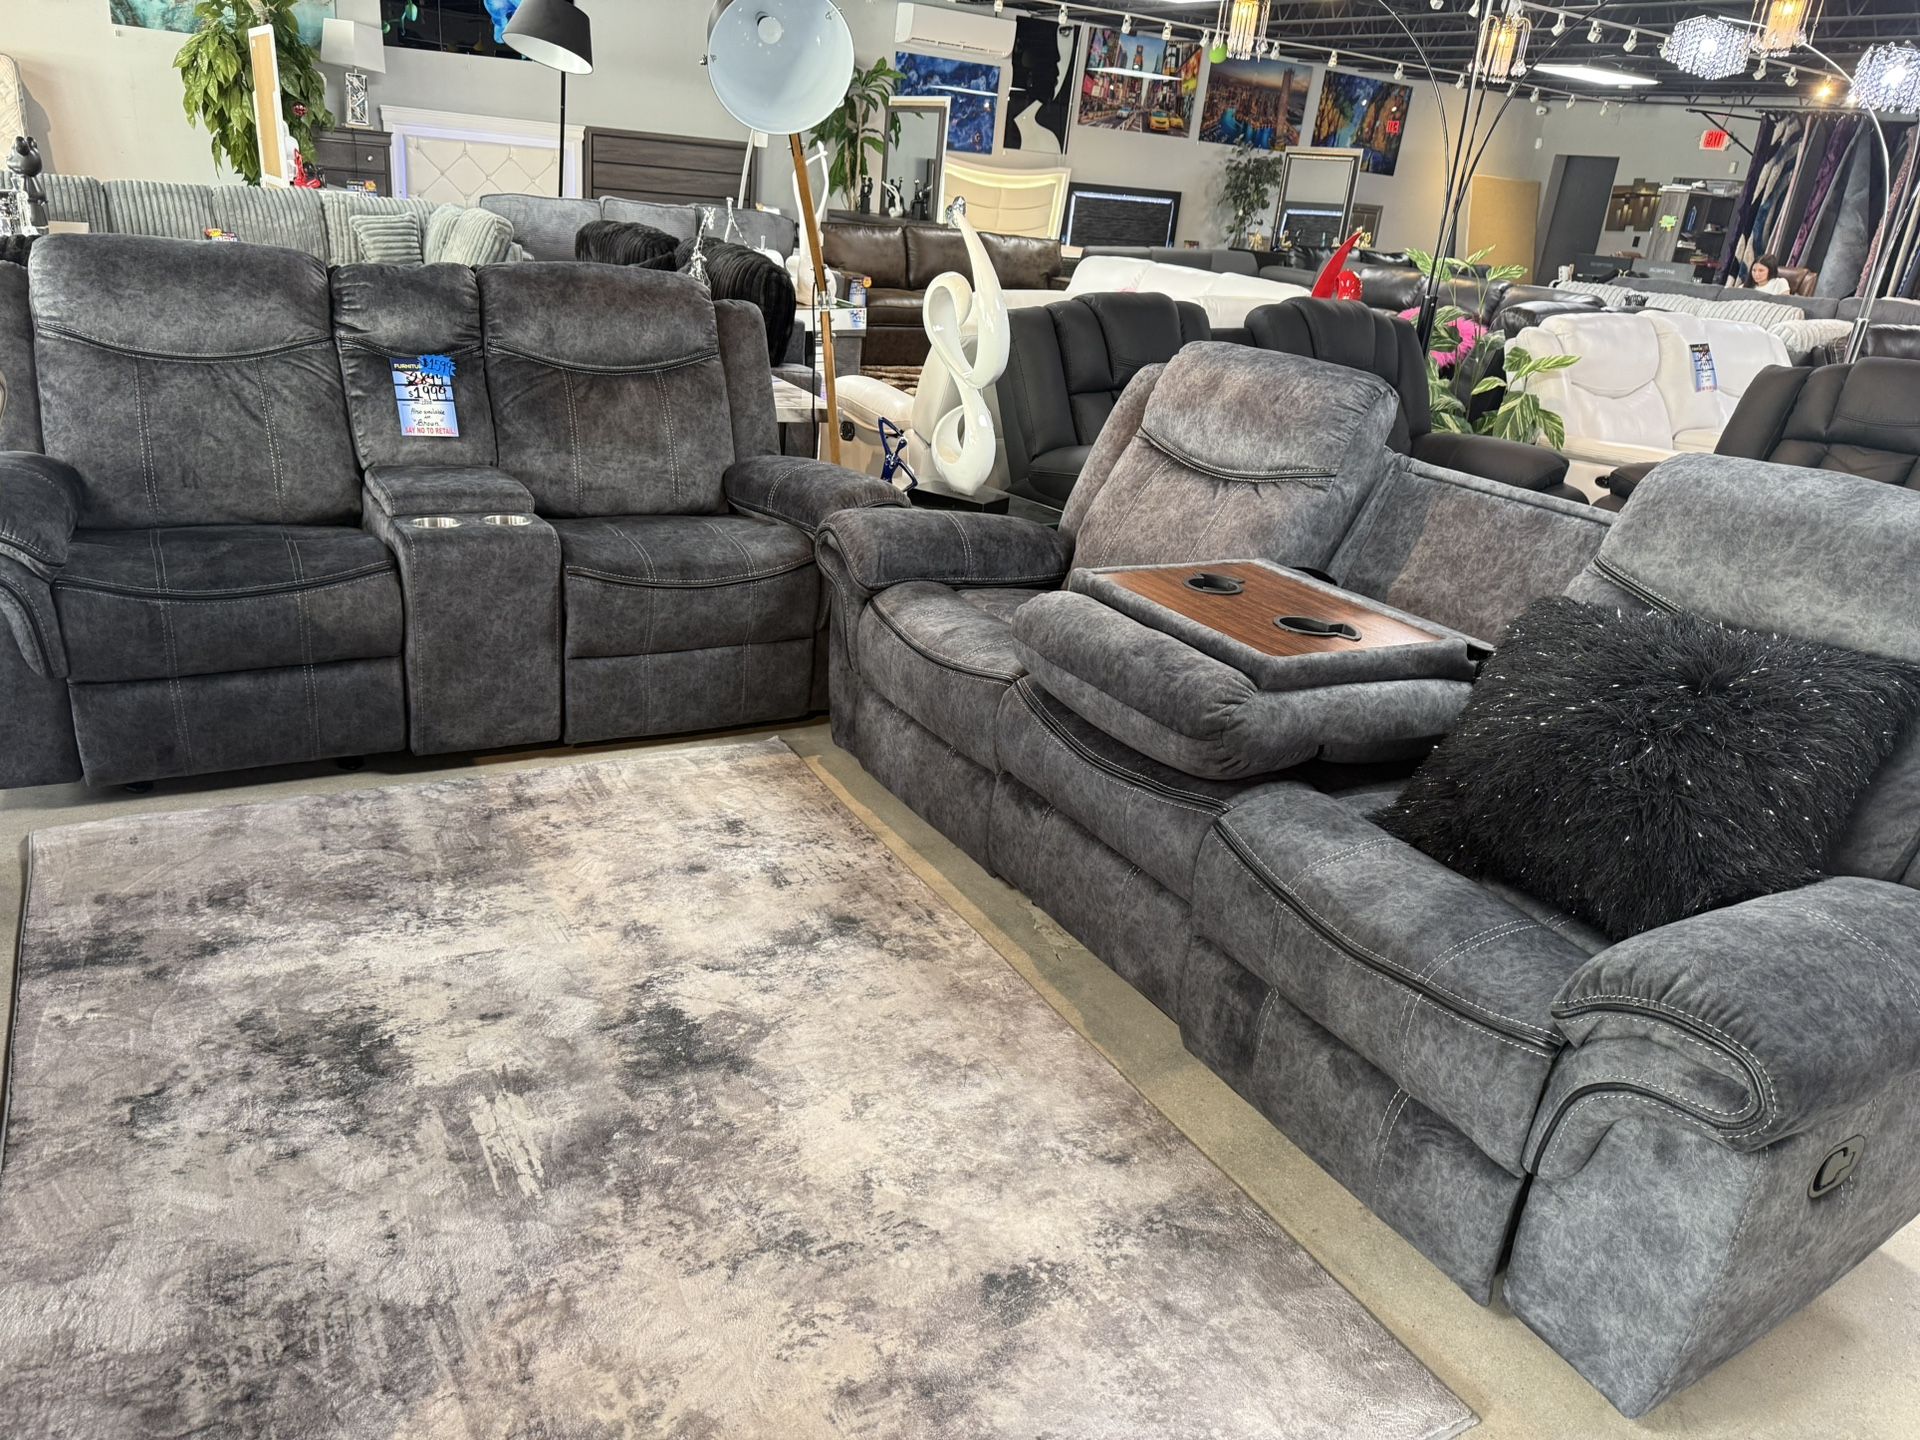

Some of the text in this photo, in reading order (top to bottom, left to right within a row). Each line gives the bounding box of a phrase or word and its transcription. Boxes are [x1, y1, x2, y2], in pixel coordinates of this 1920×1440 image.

[1704, 130, 1725, 148] EXIT
[422, 358, 452, 373] $1599
[408, 386, 447, 400] $1999
